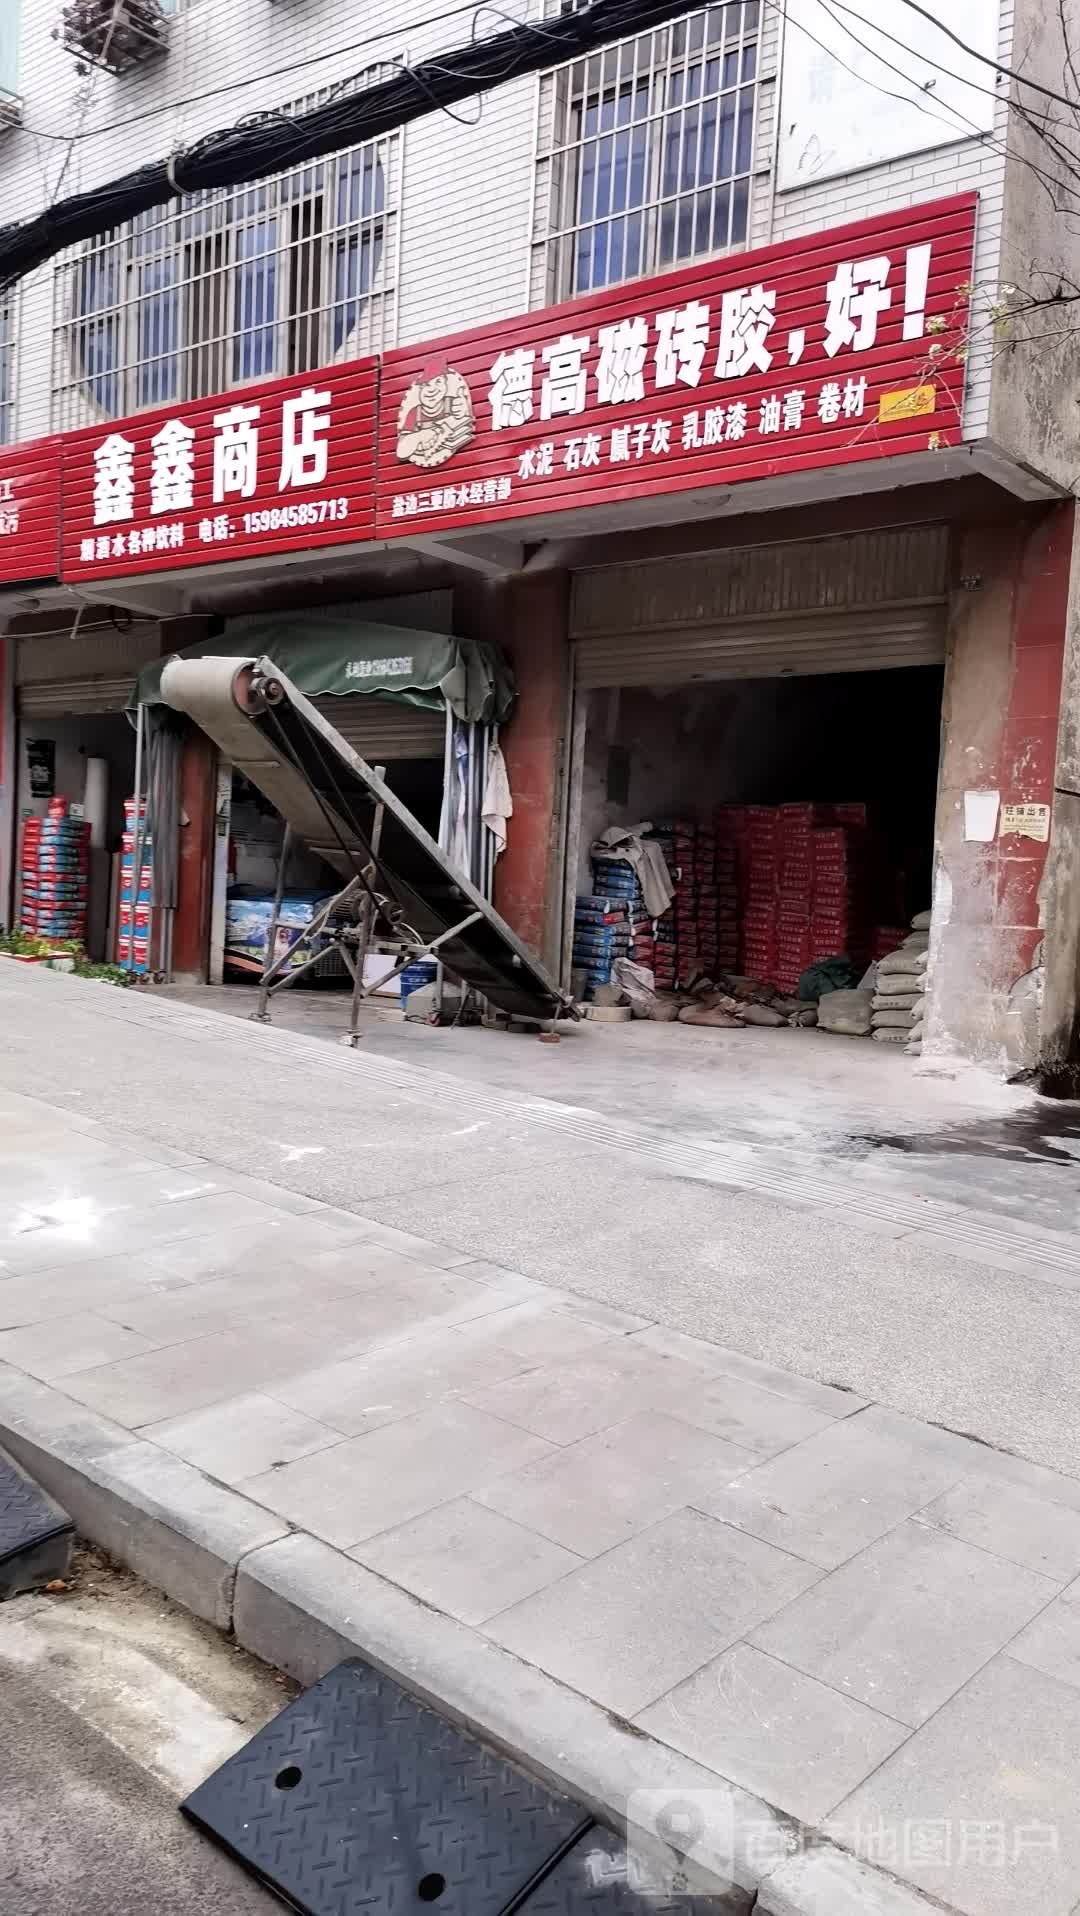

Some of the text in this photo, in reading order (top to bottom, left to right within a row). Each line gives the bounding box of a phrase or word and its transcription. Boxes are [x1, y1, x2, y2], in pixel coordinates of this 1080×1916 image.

[93, 388, 331, 526] 鑫鑫商店
[518, 443, 554, 479] 水泥
[564, 433, 602, 471] 石灰
[610, 418, 672, 463] 腻子灰
[682, 401, 748, 450] 乳胶漆
[758, 389, 806, 434] 油膏
[817, 376, 868, 424] 卷材
[80, 522, 185, 562] 烟酒水各种饮料
[242, 497, 349, 534] 15984585713
